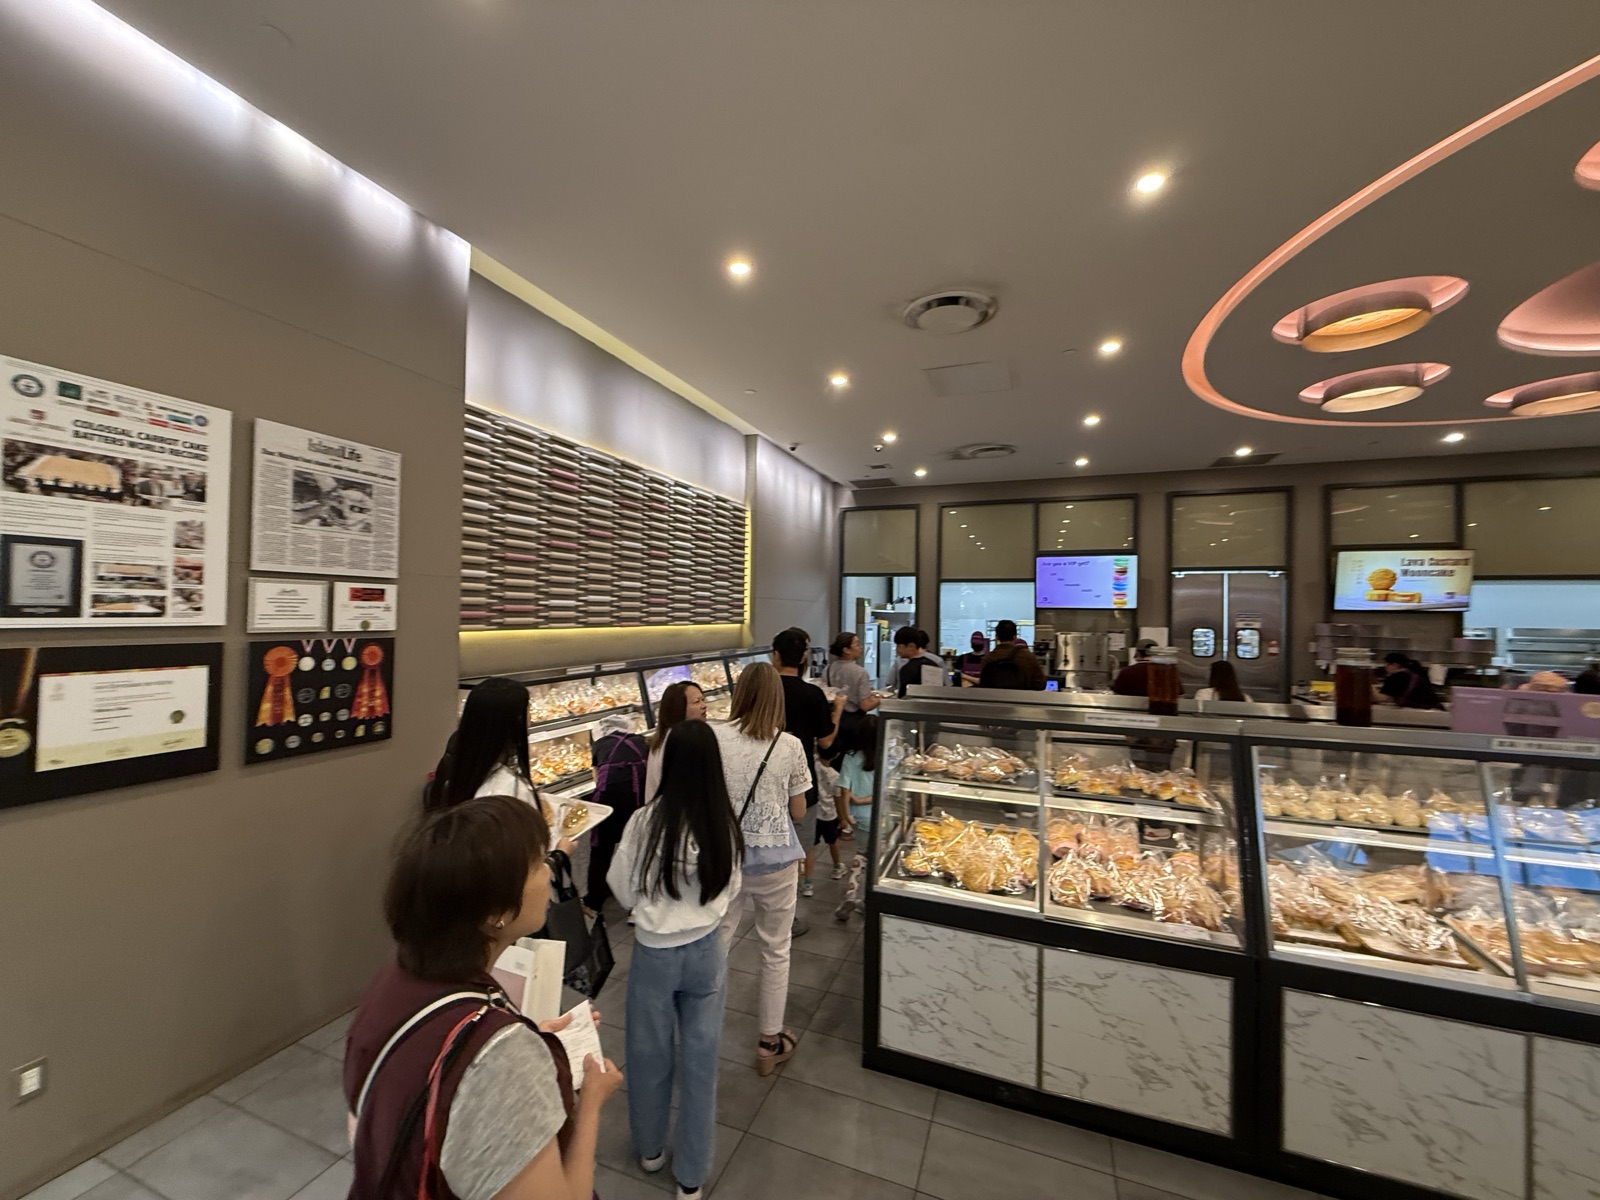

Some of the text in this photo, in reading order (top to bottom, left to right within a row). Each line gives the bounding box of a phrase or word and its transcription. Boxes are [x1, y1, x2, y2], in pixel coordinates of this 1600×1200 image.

[72, 418, 136, 438] COLOSSAL
[137, 431, 181, 447] CARROT
[182, 440, 209, 453] CAKE
[72, 429, 209, 462] BATTERS WORLD RECORD
[1400, 557, 1426, 567] Lava
[1400, 569, 1456, 577] Mooncake
